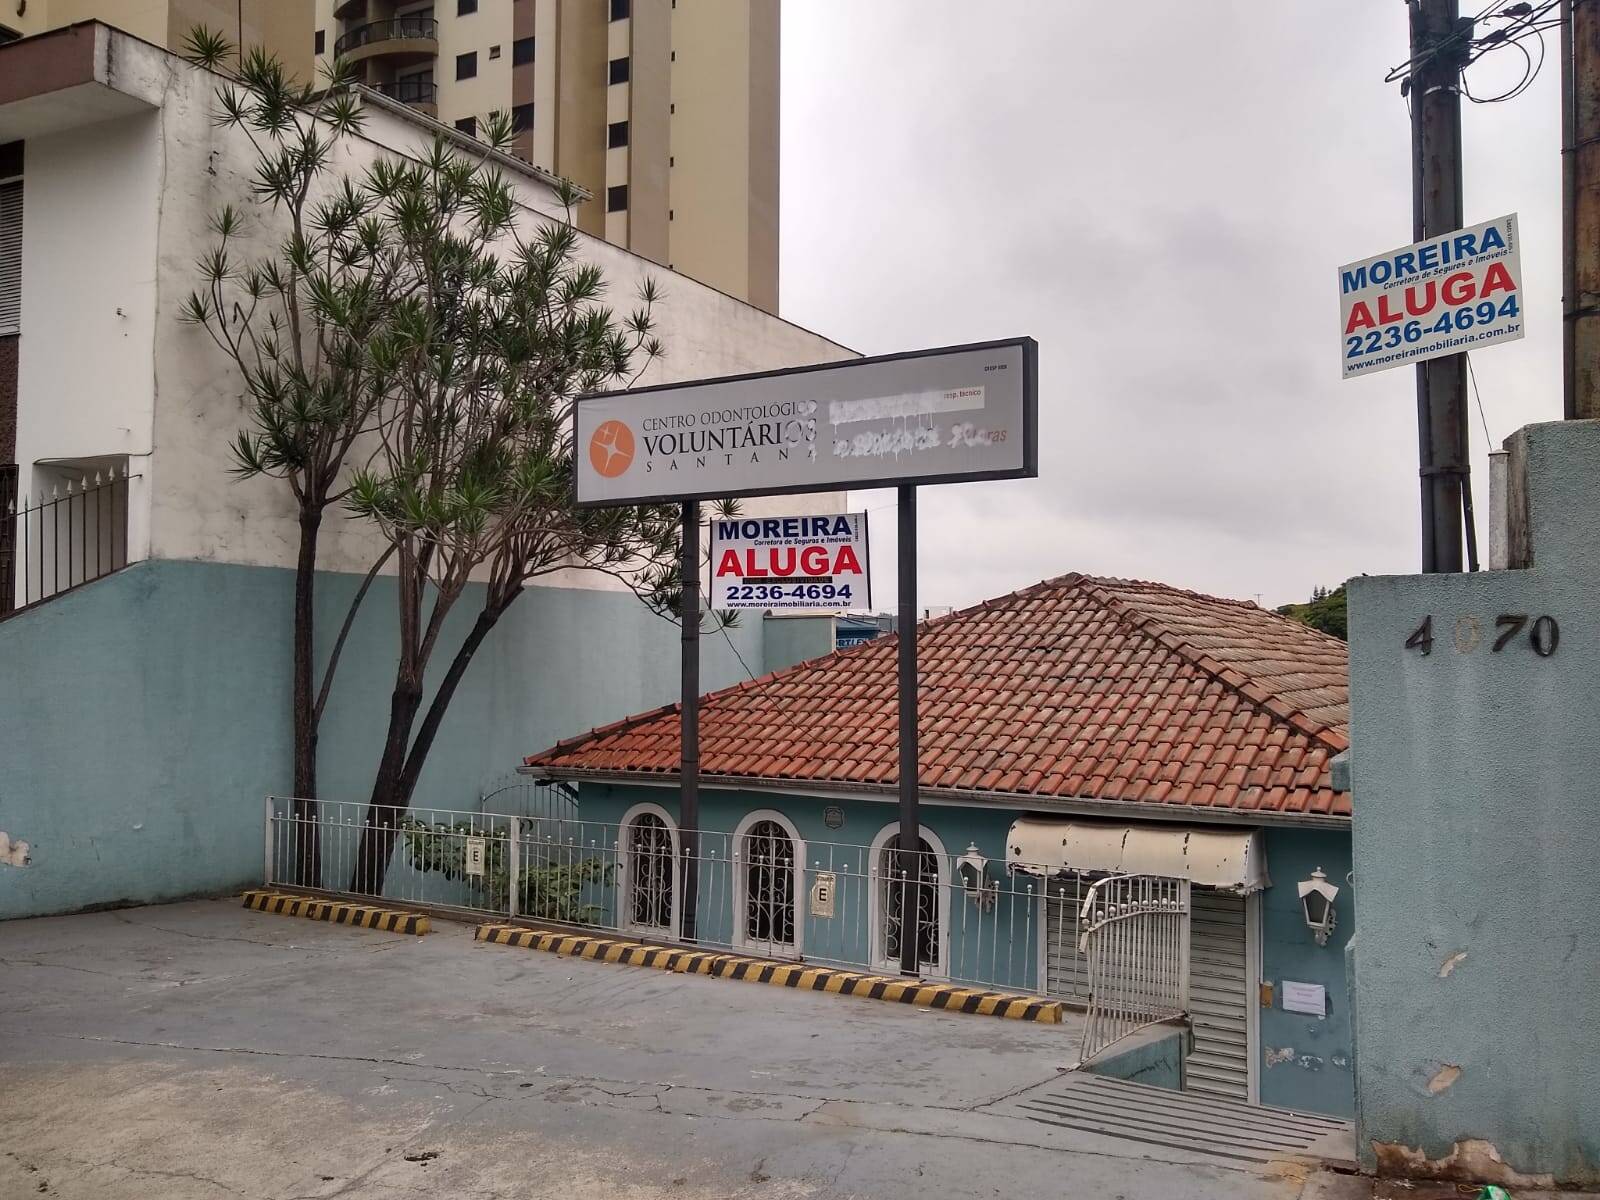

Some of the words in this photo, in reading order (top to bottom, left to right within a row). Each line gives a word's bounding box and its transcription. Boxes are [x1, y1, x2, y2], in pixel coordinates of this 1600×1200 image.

[1342, 226, 1506, 294] MOREIRA
[1383, 274, 1420, 290] Corretora
[1421, 270, 1432, 279] de
[1433, 260, 1466, 277] Seguros
[1345, 261, 1518, 335] ALUGA
[1346, 294, 1520, 359] 2236-4694
[1347, 323, 1521, 371] www.moreiraimobiliaria.com.br
[642, 414, 696, 432] CENTRO
[718, 516, 852, 541] MOREIRA
[754, 538, 783, 546] Corretora
[793, 537, 819, 545] Seguros
[716, 545, 863, 577] ALUGA
[726, 584, 852, 600] 2236-4694
[727, 600, 852, 608] www.moreiraimobiliaria.com.br
[473, 851, 479, 862] E
[819, 888, 827, 901] E
